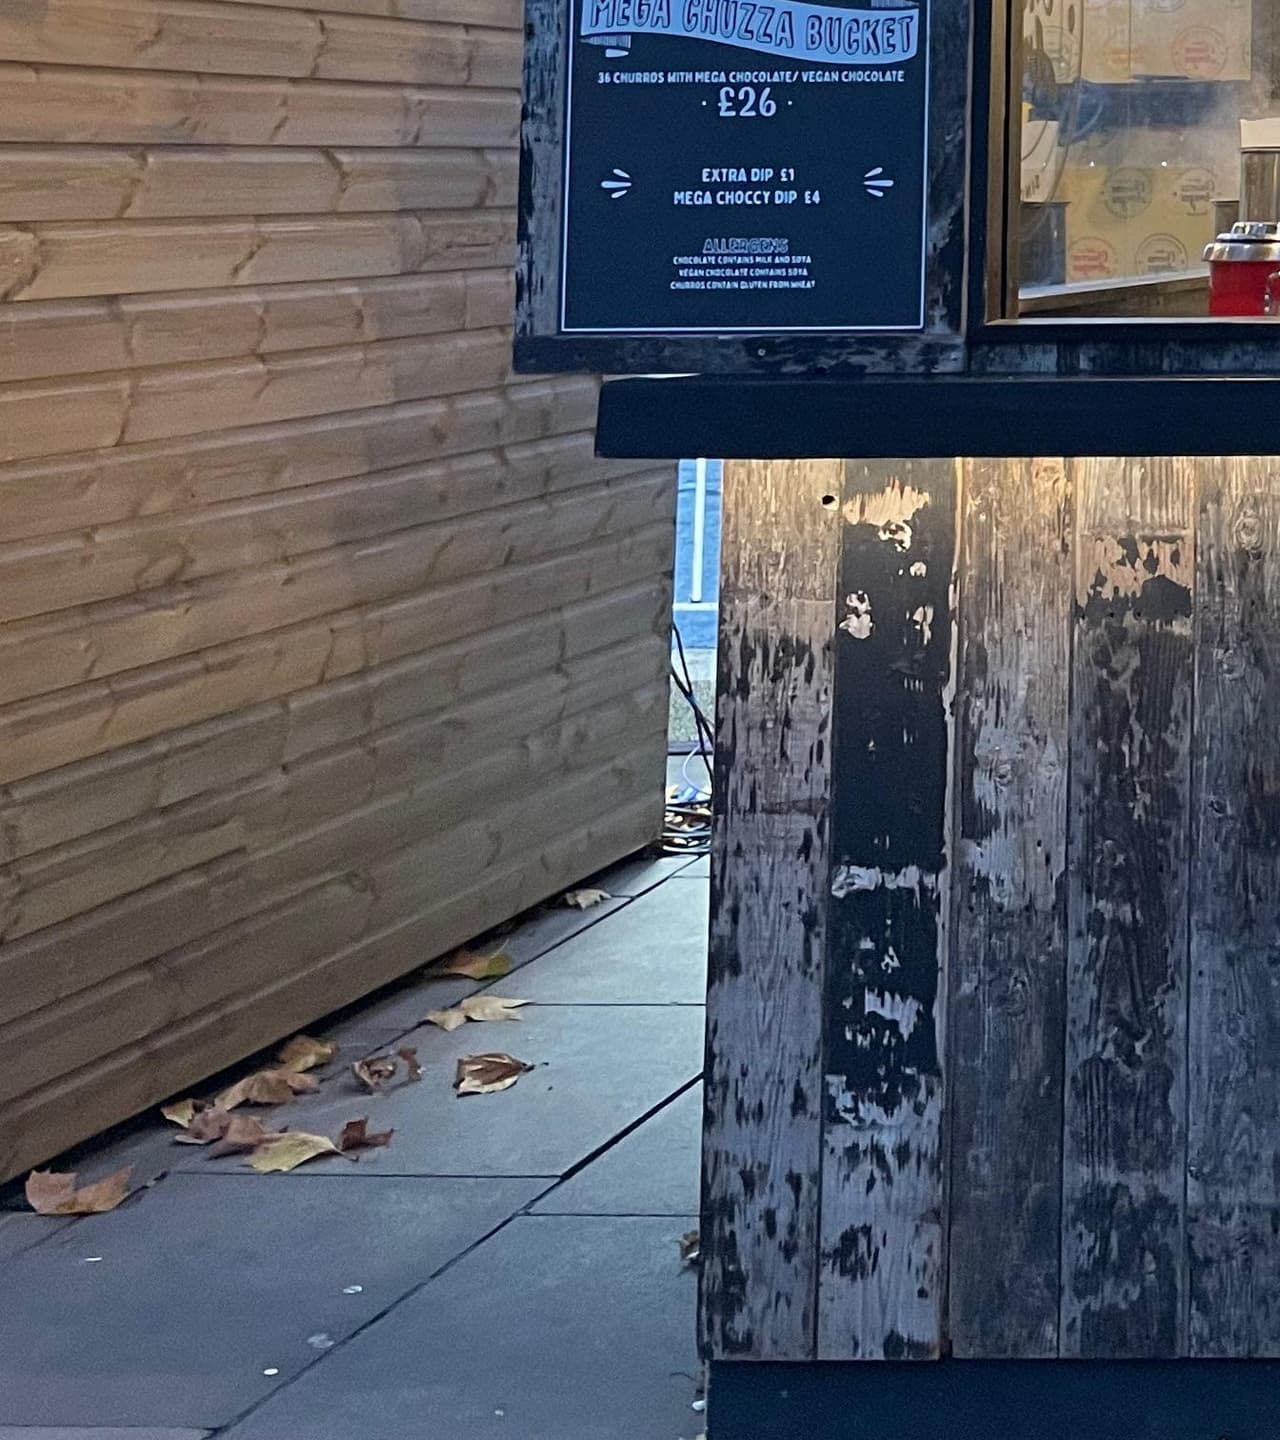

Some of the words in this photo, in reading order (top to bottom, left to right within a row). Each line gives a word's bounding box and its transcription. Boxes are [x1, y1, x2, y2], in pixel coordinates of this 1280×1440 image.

[806, 15, 914, 56] BUCKET
[598, 72, 611, 83] 36
[613, 72, 664, 83] CHURROS
[667, 72, 693, 83] WITH
[695, 72, 726, 83] MEGA
[801, 71, 838, 82] VEGAN
[841, 70, 904, 82] CHOCOLATE
[717, 87, 776, 117] £26
[702, 168, 747, 182] EXTRA
[751, 168, 773, 182] DIP
[780, 168, 794, 182] £1
[673, 191, 712, 205] MEGA
[716, 191, 770, 205] CHOCCY
[774, 191, 797, 205] DIP
[804, 190, 820, 205] £4
[702, 237, 789, 254] ALLERGENS
[673, 256, 716, 264] CHOCOLATE
[718, 256, 754, 264] CONTAINS
[755, 256, 772, 264] MILK
[774, 255, 790, 264] AND
[791, 255, 811, 264] SOYA
[679, 268, 704, 276] VEGAN
[706, 268, 748, 276] CHOCOLATE
[750, 268, 786, 276] CONTAINS
[787, 268, 808, 276] SOYA
[670, 281, 705, 290] CHURROS
[707, 281, 738, 289] CONTAIN
[740, 281, 767, 289] GLUTEN
[769, 281, 789, 289] FROM
[790, 281, 815, 289] WHEAT
